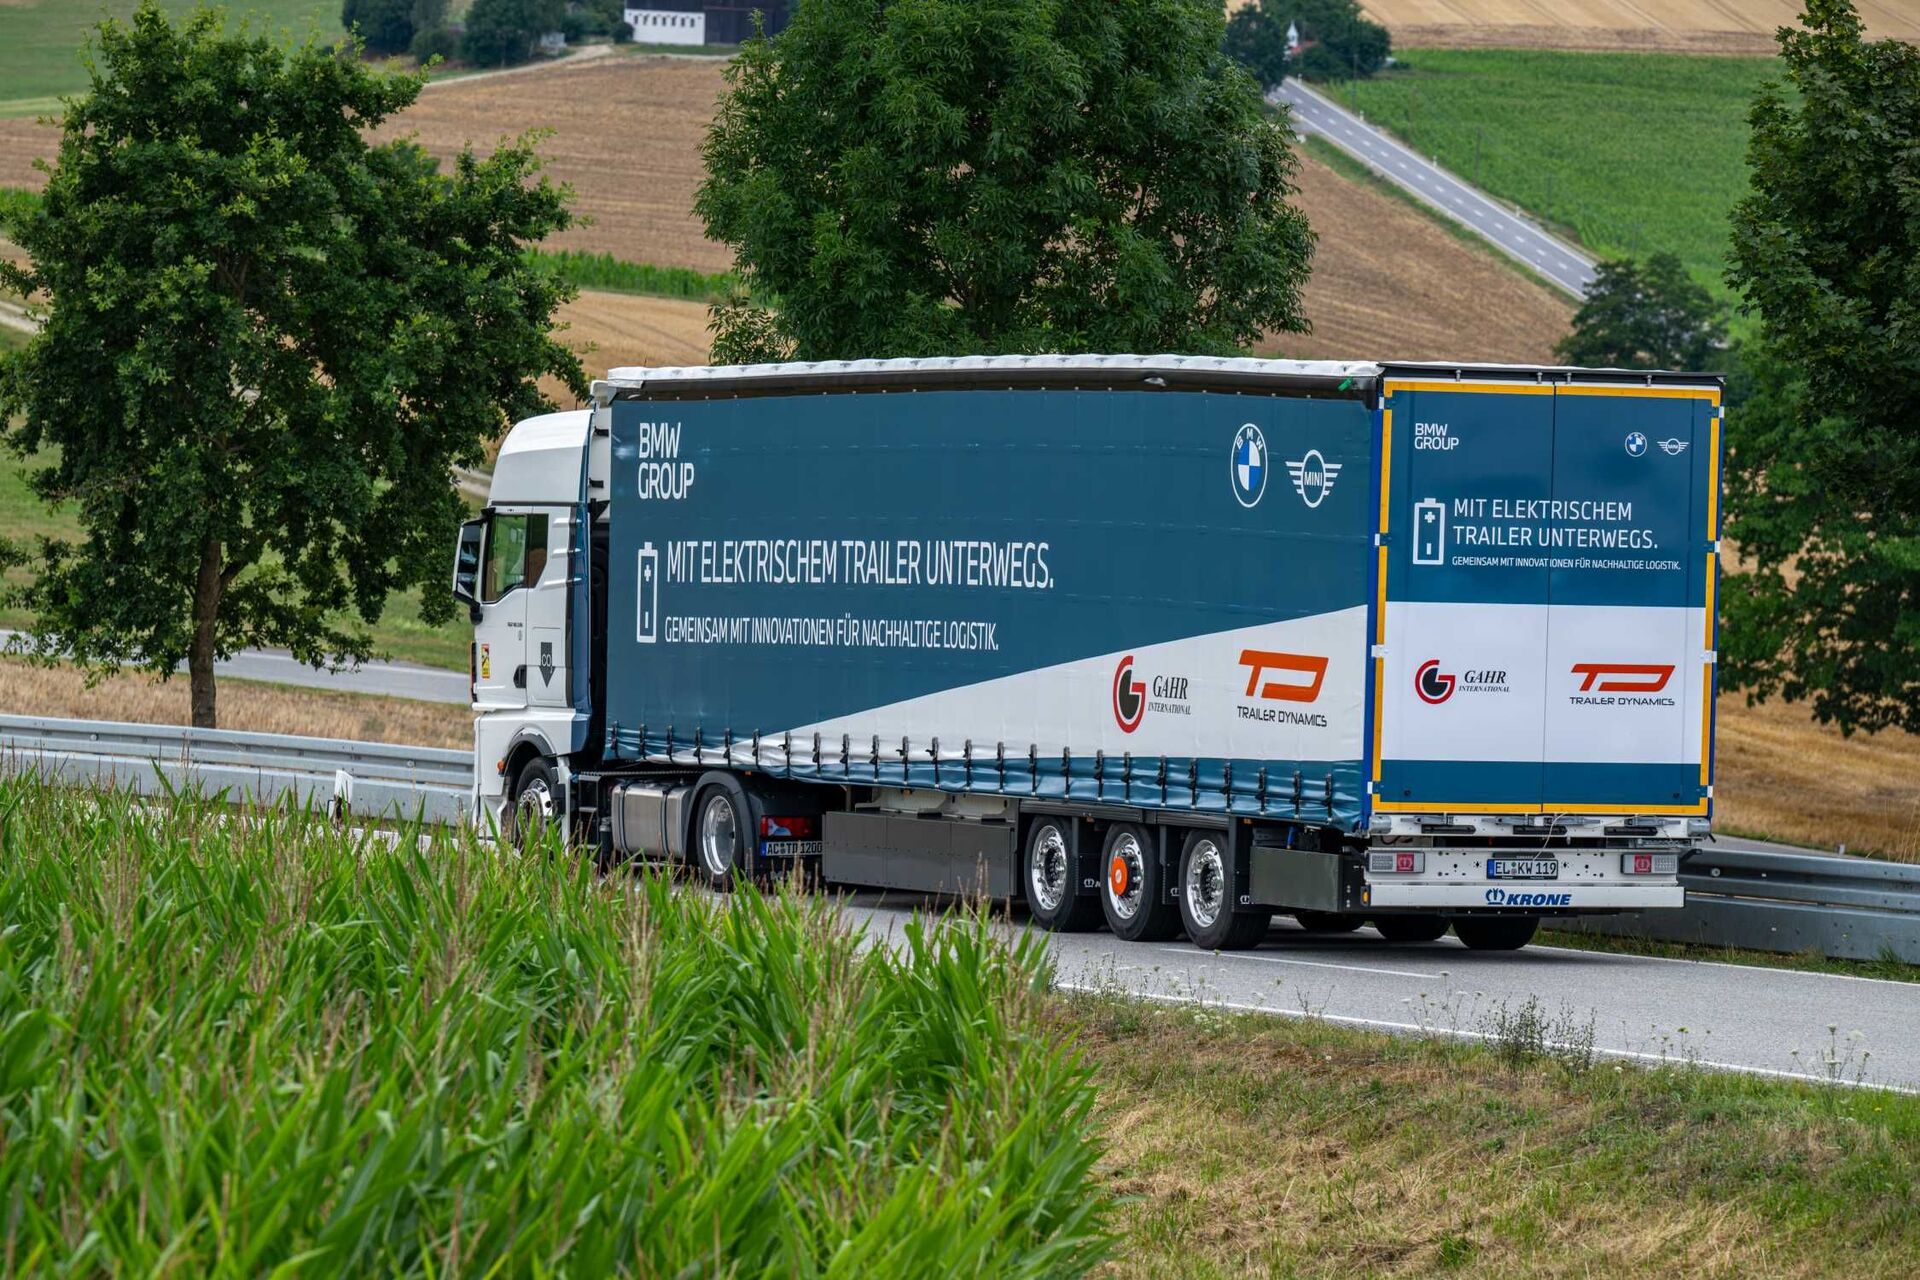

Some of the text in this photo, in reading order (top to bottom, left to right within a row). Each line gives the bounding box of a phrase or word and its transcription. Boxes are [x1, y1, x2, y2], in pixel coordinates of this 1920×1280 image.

[1414, 423, 1448, 436] BMW
[639, 422, 682, 459] BMW
[1414, 437, 1460, 450] GROUP
[638, 461, 695, 500] GROUP
[1303, 471, 1323, 487] MINI
[1454, 498, 1632, 521] MIT ELEKTRISCHEM
[1453, 525, 1658, 549] TRAILER UNTERWEGS.
[667, 539, 1054, 588] MIT ELEKTRISCHEM TRAILER UNTERWEGS.
[1452, 556, 1499, 567] GEMEINSAM
[1500, 557, 1515, 567] MIT
[1575, 556, 1591, 569] FÜR
[1592, 560, 1645, 570] NACHHALTIGE
[1645, 561, 1681, 570] LOGISTIK.
[665, 613, 999, 651] GEMEINSAM MIT INNOVATIONEN FÜR NACHHALTIGE LOGISTIK.
[1464, 670, 1506, 684] GAHR
[1152, 675, 1189, 700] GAHR
[1459, 685, 1511, 693] INTERNATIONAL
[1148, 701, 1191, 715] INTERNATIONAL
[1570, 697, 1675, 706] TRAILER DYNAMICS
[1237, 706, 1328, 728] TRAILER DYNAMICS
[1495, 862, 1557, 875] EL KW 119
[1506, 894, 1572, 906] KRONE
